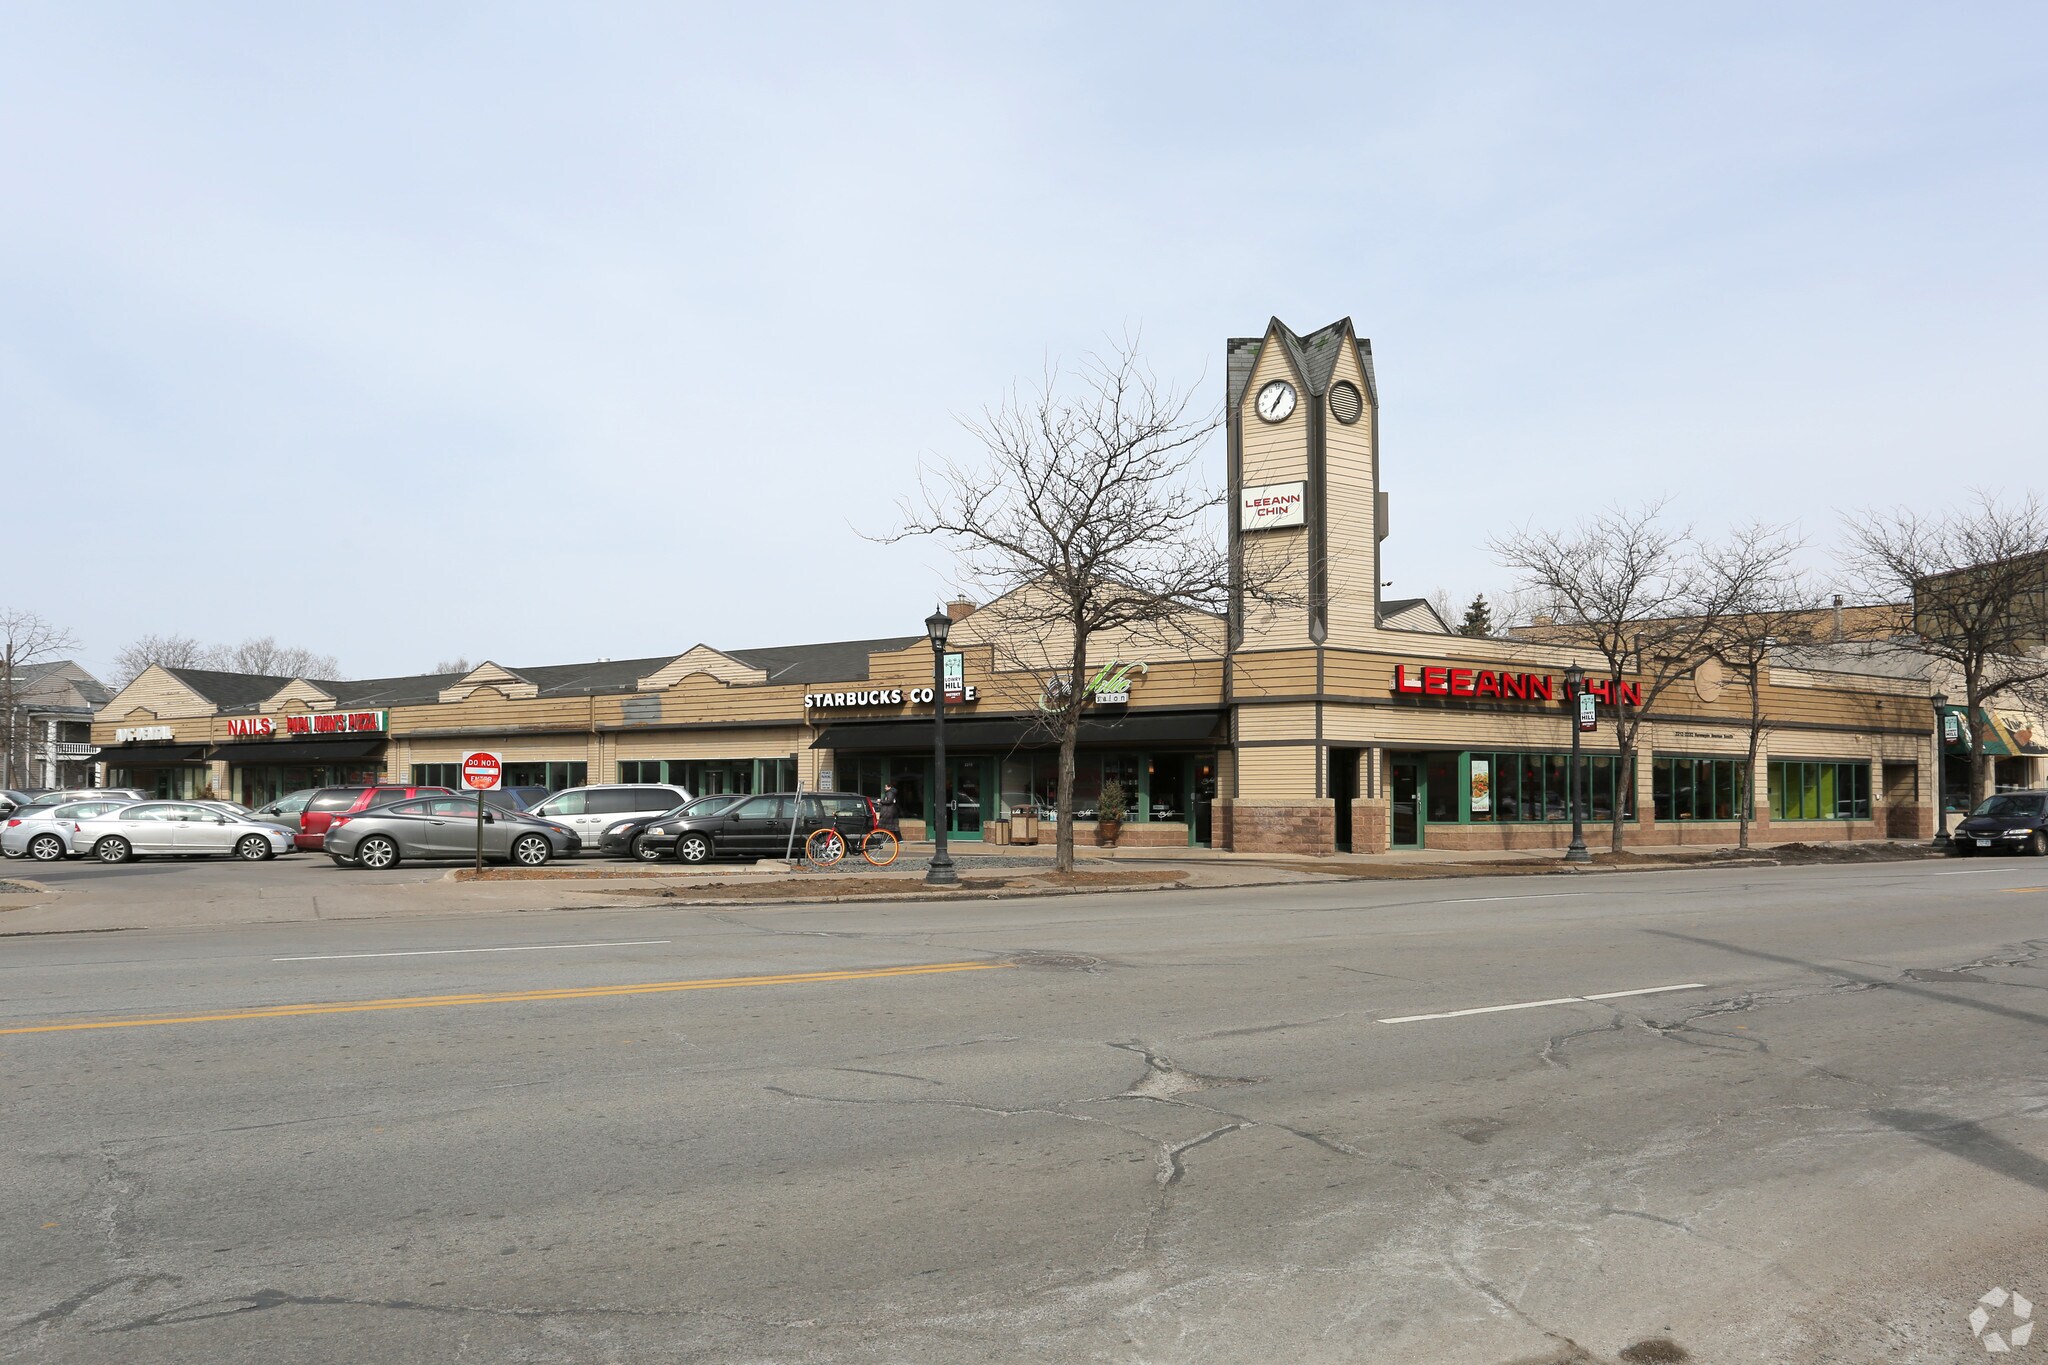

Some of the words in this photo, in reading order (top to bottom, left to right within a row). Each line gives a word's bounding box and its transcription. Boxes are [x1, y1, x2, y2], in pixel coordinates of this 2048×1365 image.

[1245, 494, 1300, 508] LEEANN
[1257, 505, 1289, 516] CHIN
[1394, 664, 1553, 701] LEEANN
[804, 688, 904, 708] STARBUCKS
[910, 685, 977, 704] COE
[1097, 693, 1126, 702] salon
[227, 717, 273, 736] NAILS
[287, 716, 310, 734] PAPA
[314, 713, 346, 732] JOHN'S
[348, 712, 377, 731] PIZZA
